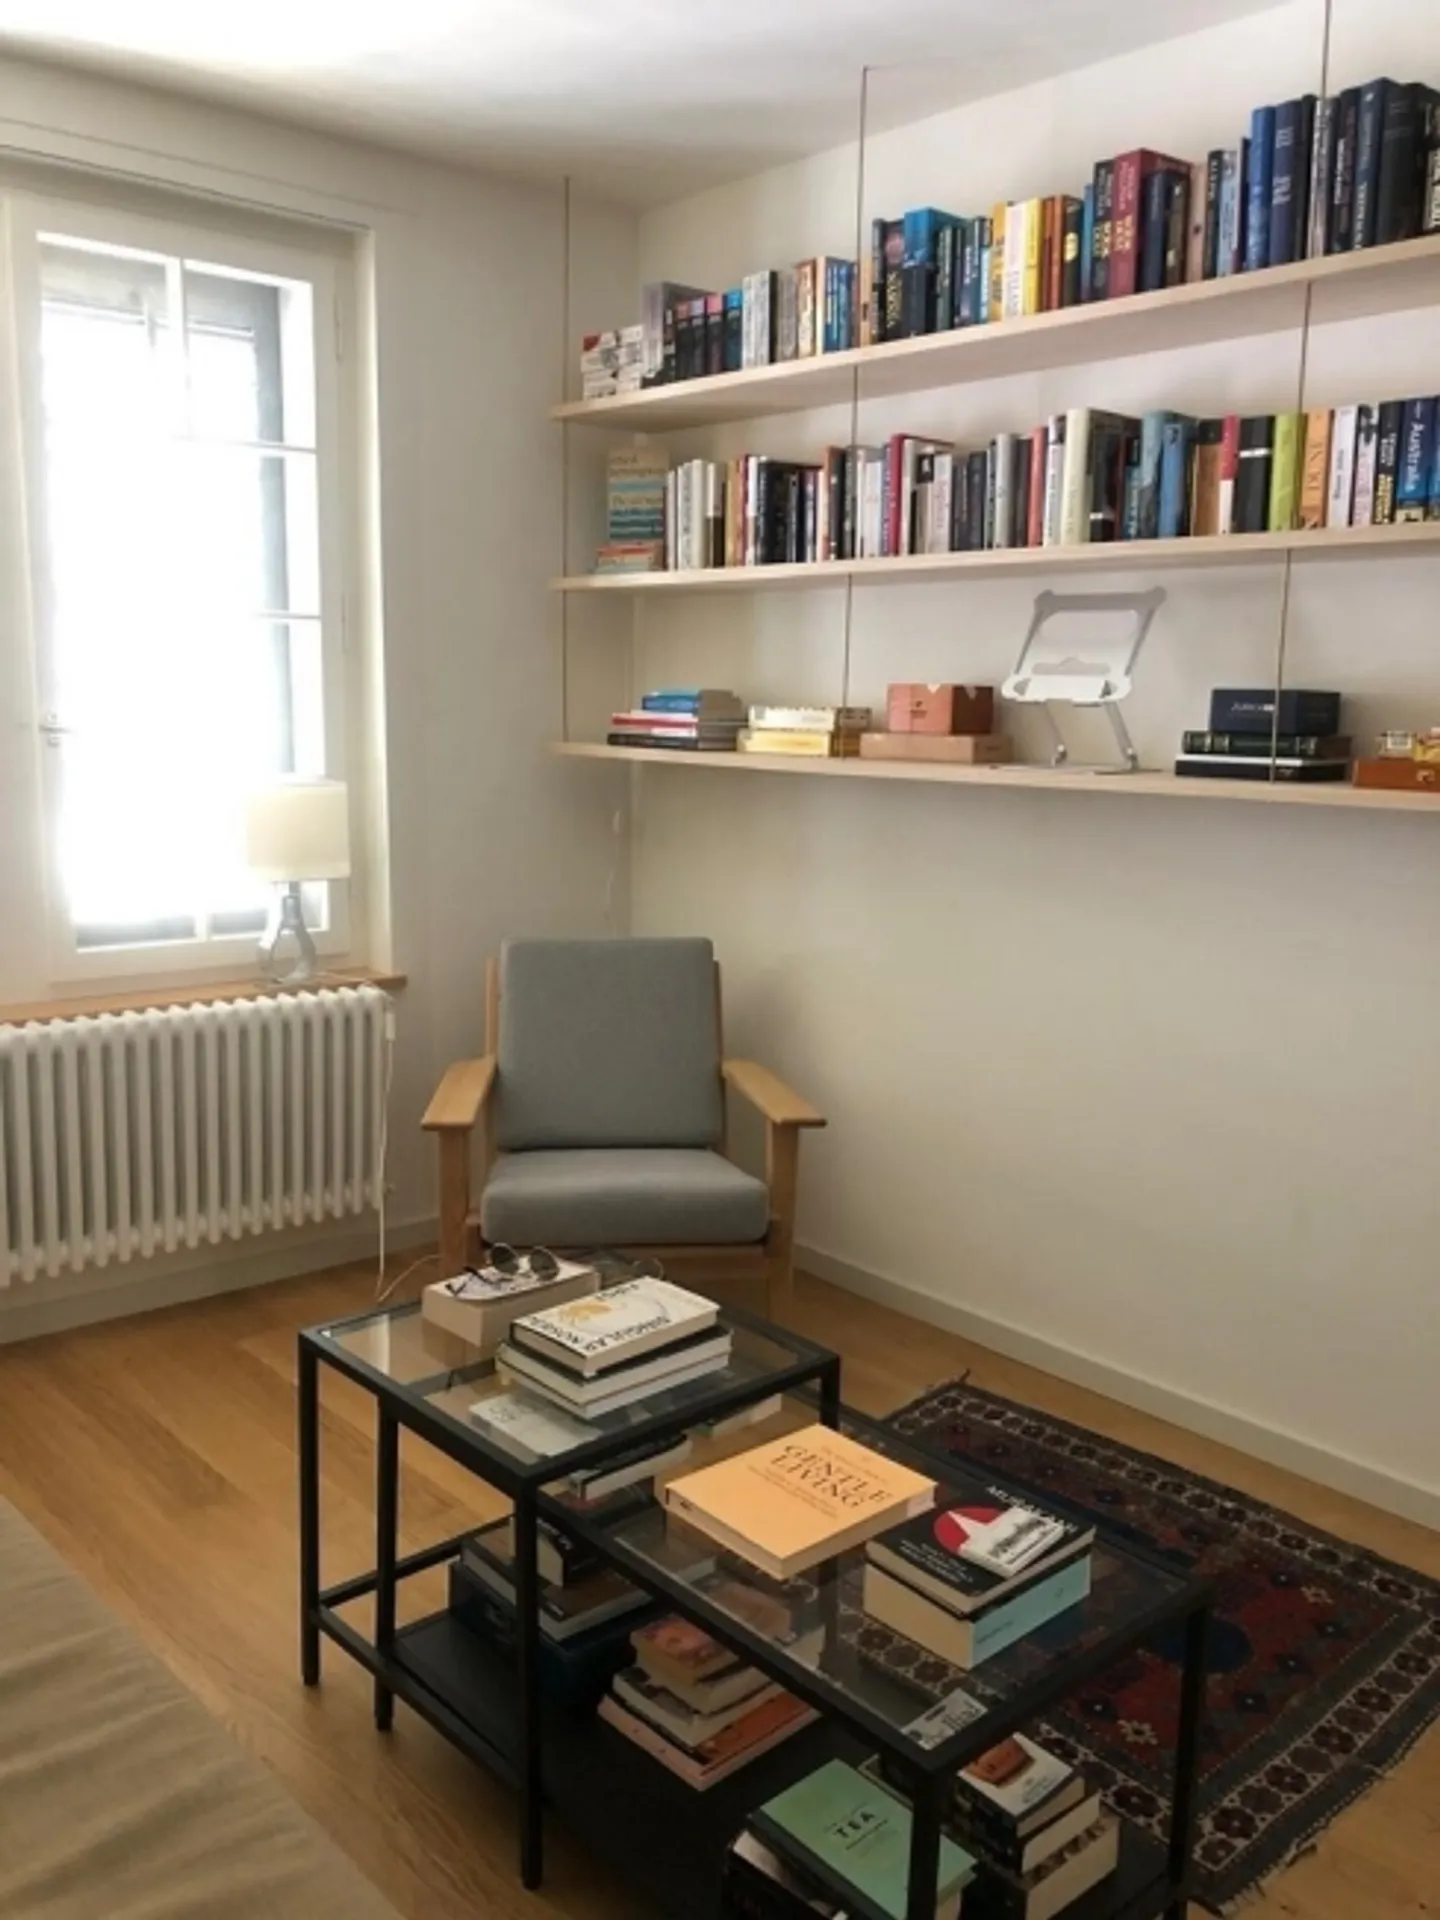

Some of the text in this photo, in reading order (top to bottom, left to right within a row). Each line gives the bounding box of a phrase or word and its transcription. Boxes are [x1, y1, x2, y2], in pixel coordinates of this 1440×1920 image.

[1406, 422, 1425, 493] Australia
[771, 1454, 864, 1507] LIVING
[785, 1445, 893, 1502] GENTLE
[834, 1811, 876, 1839] TEA
